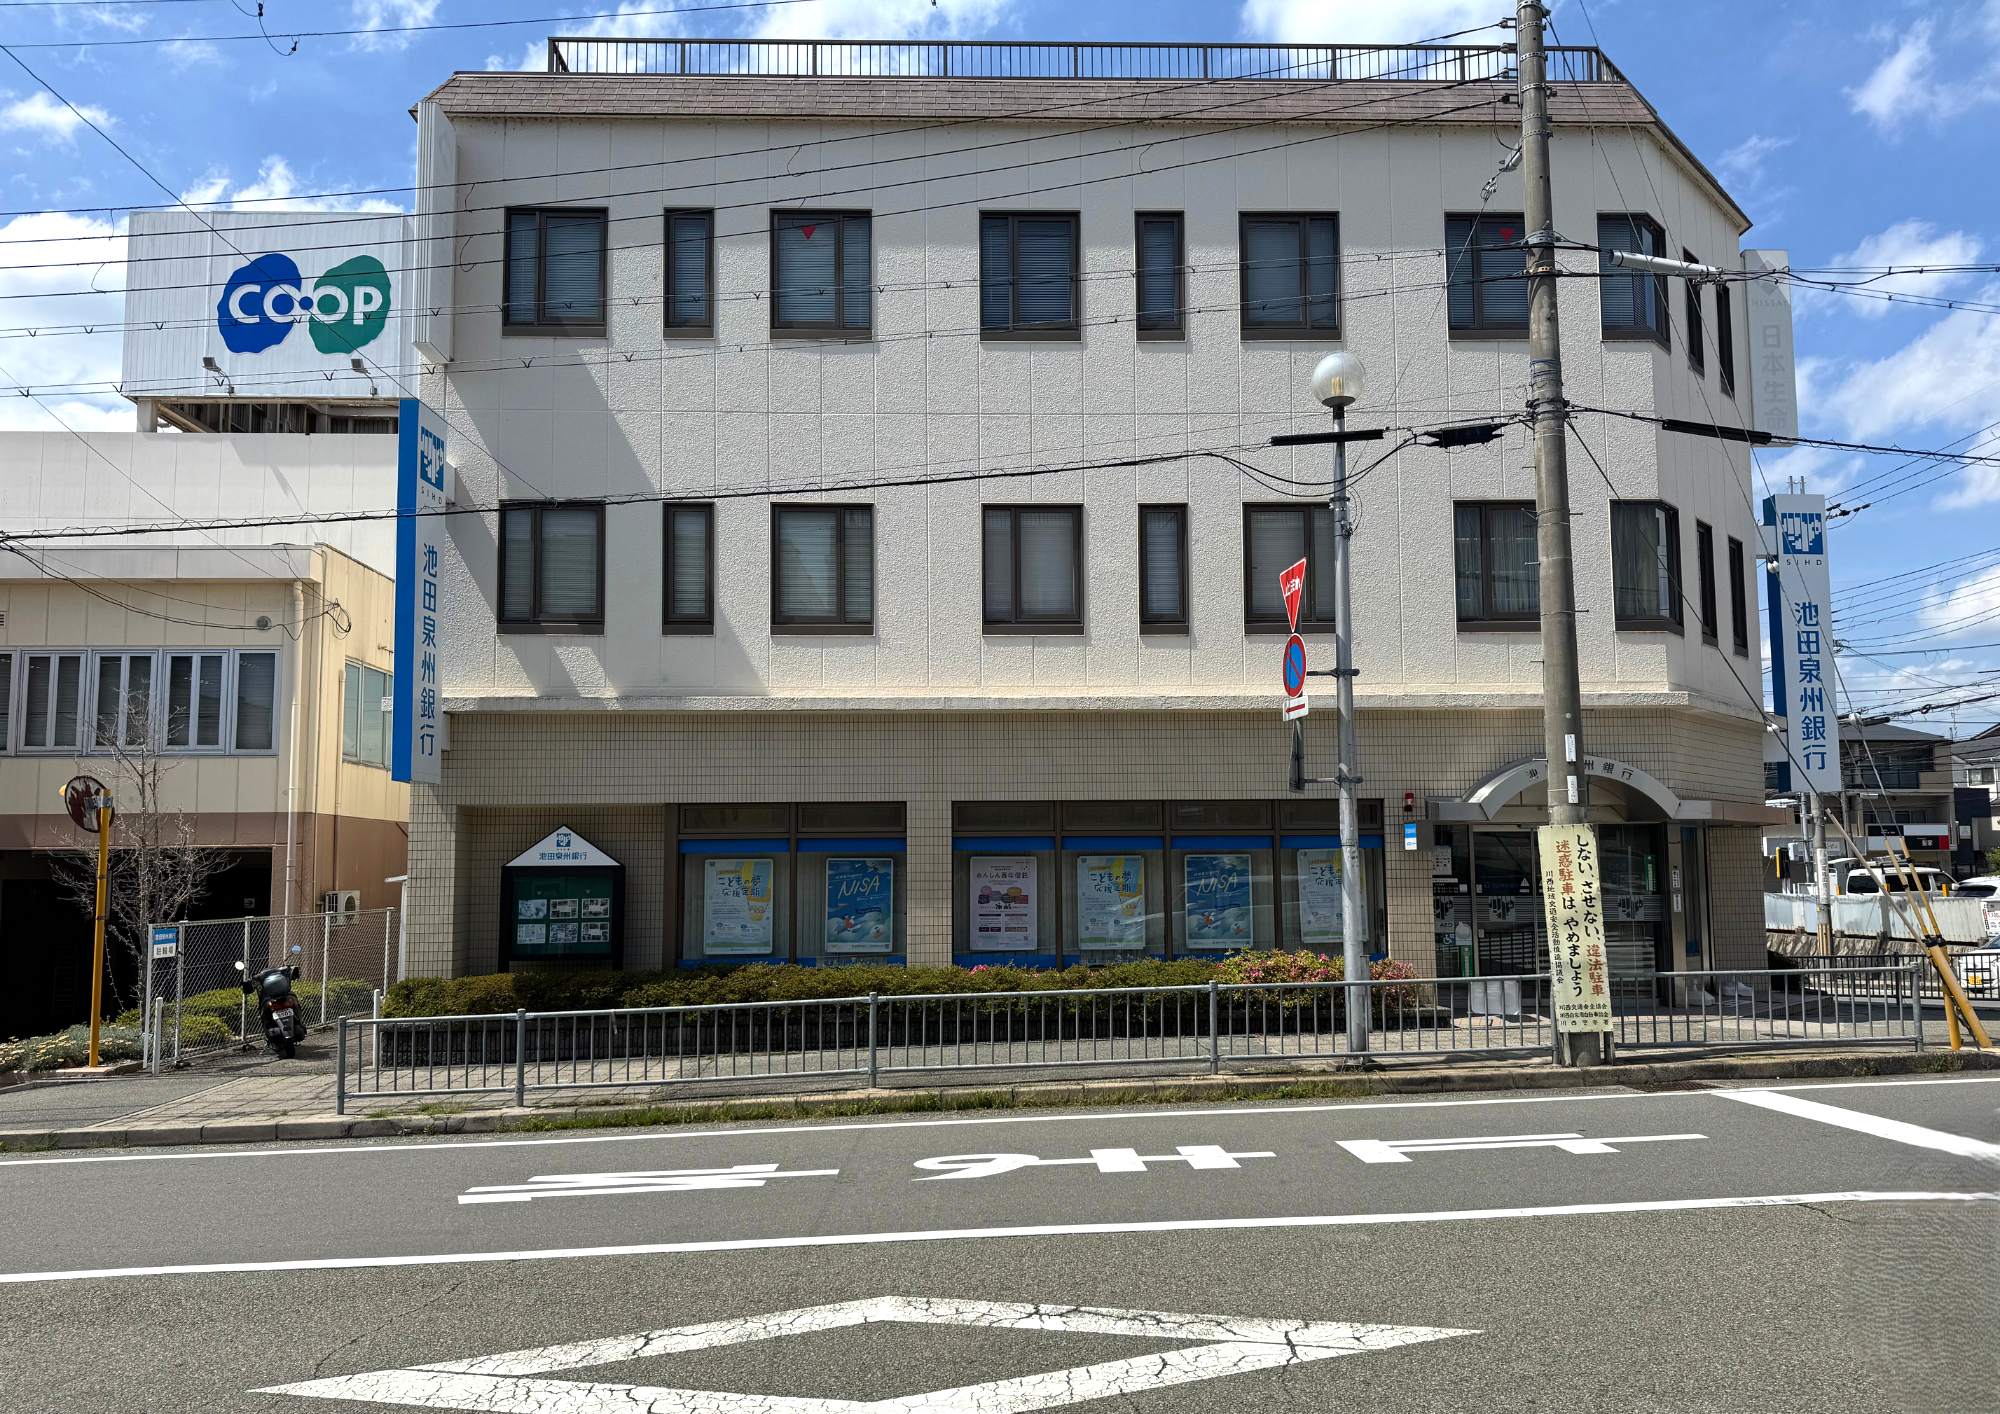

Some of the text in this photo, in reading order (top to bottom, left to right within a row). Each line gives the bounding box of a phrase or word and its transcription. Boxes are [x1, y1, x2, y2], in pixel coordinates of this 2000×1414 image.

[1751, 297, 1791, 308] NISSAY
[1761, 325, 1788, 429] 日本生命
[420, 484, 443, 506] SIHD
[1785, 557, 1824, 567] SIHD
[418, 542, 439, 758] 池田泉州銀行
[1793, 602, 1828, 771] 池田泉州銀行
[1525, 758, 1635, 783] 池州銀行
[539, 851, 588, 861] 池田泉州銀行
[717, 874, 762, 888] こどもの夢
[837, 874, 881, 900] NISA
[1089, 870, 1133, 884] こどもの夢
[1196, 871, 1239, 897] NISA
[721, 886, 762, 898] 応援定期
[1555, 839, 1583, 998] 迷惑駐車は、やめましょう
[1576, 834, 1605, 997] しない、させない、違法駐車
